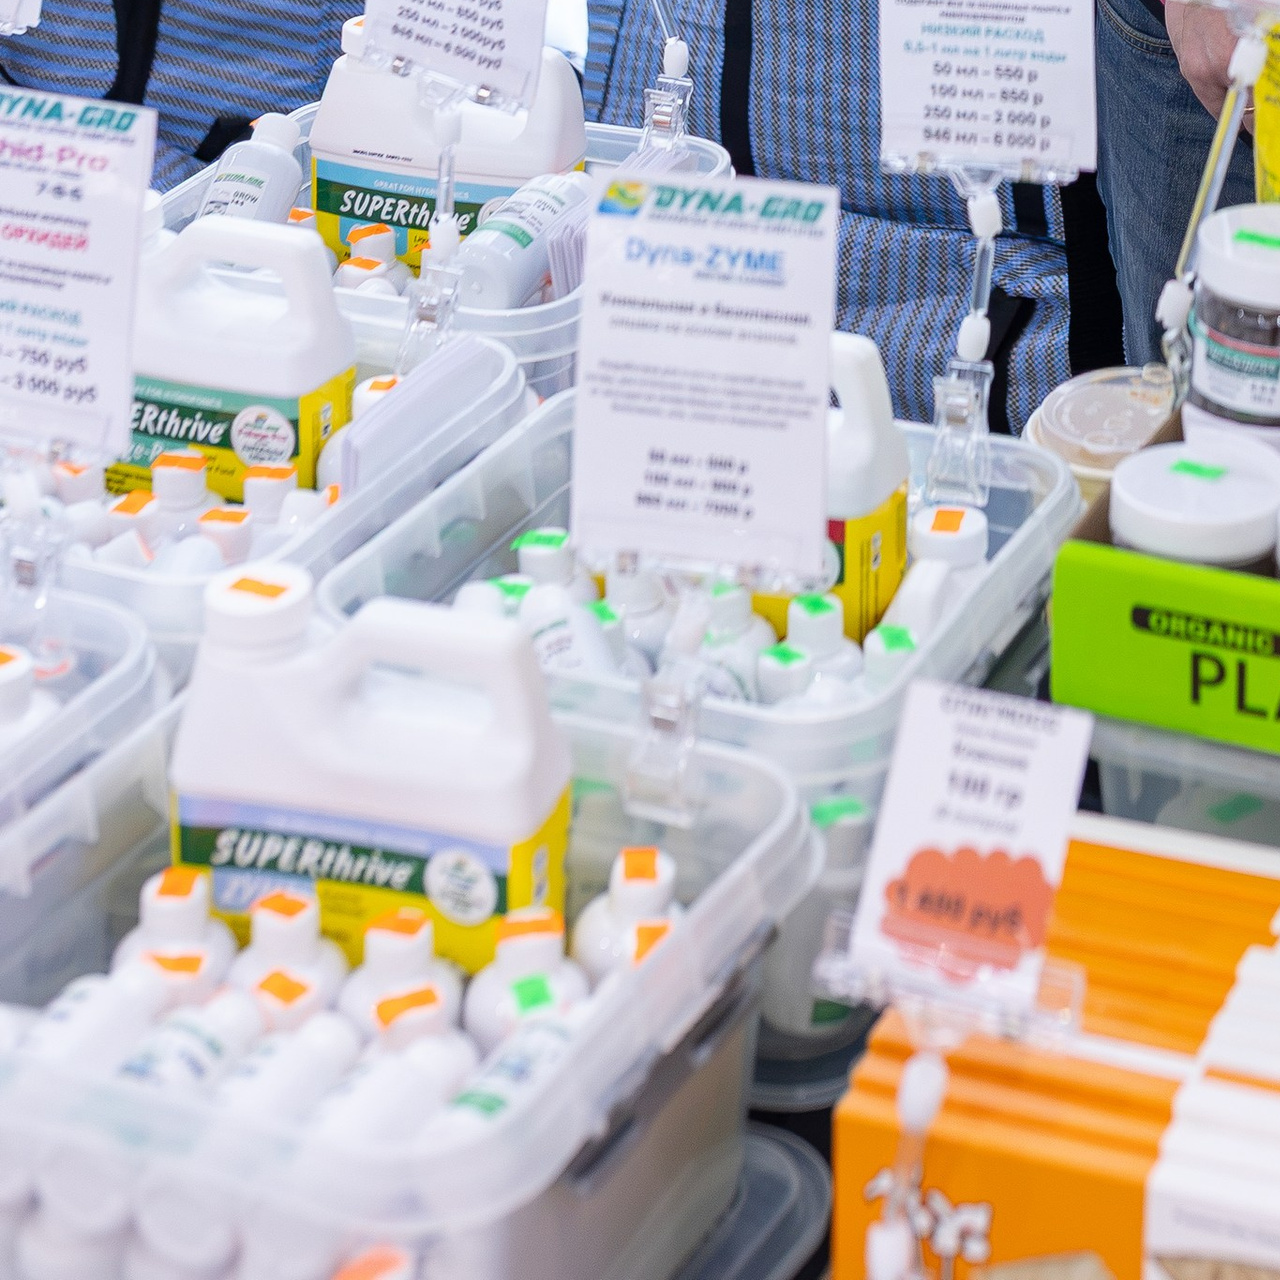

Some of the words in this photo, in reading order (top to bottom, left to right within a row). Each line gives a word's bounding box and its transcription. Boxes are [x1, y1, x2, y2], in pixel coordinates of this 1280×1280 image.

[340, 190, 473, 232] SUPERthe
[654, 185, 824, 223] DYNA-GRO
[132, 402, 230, 444] ERthrive
